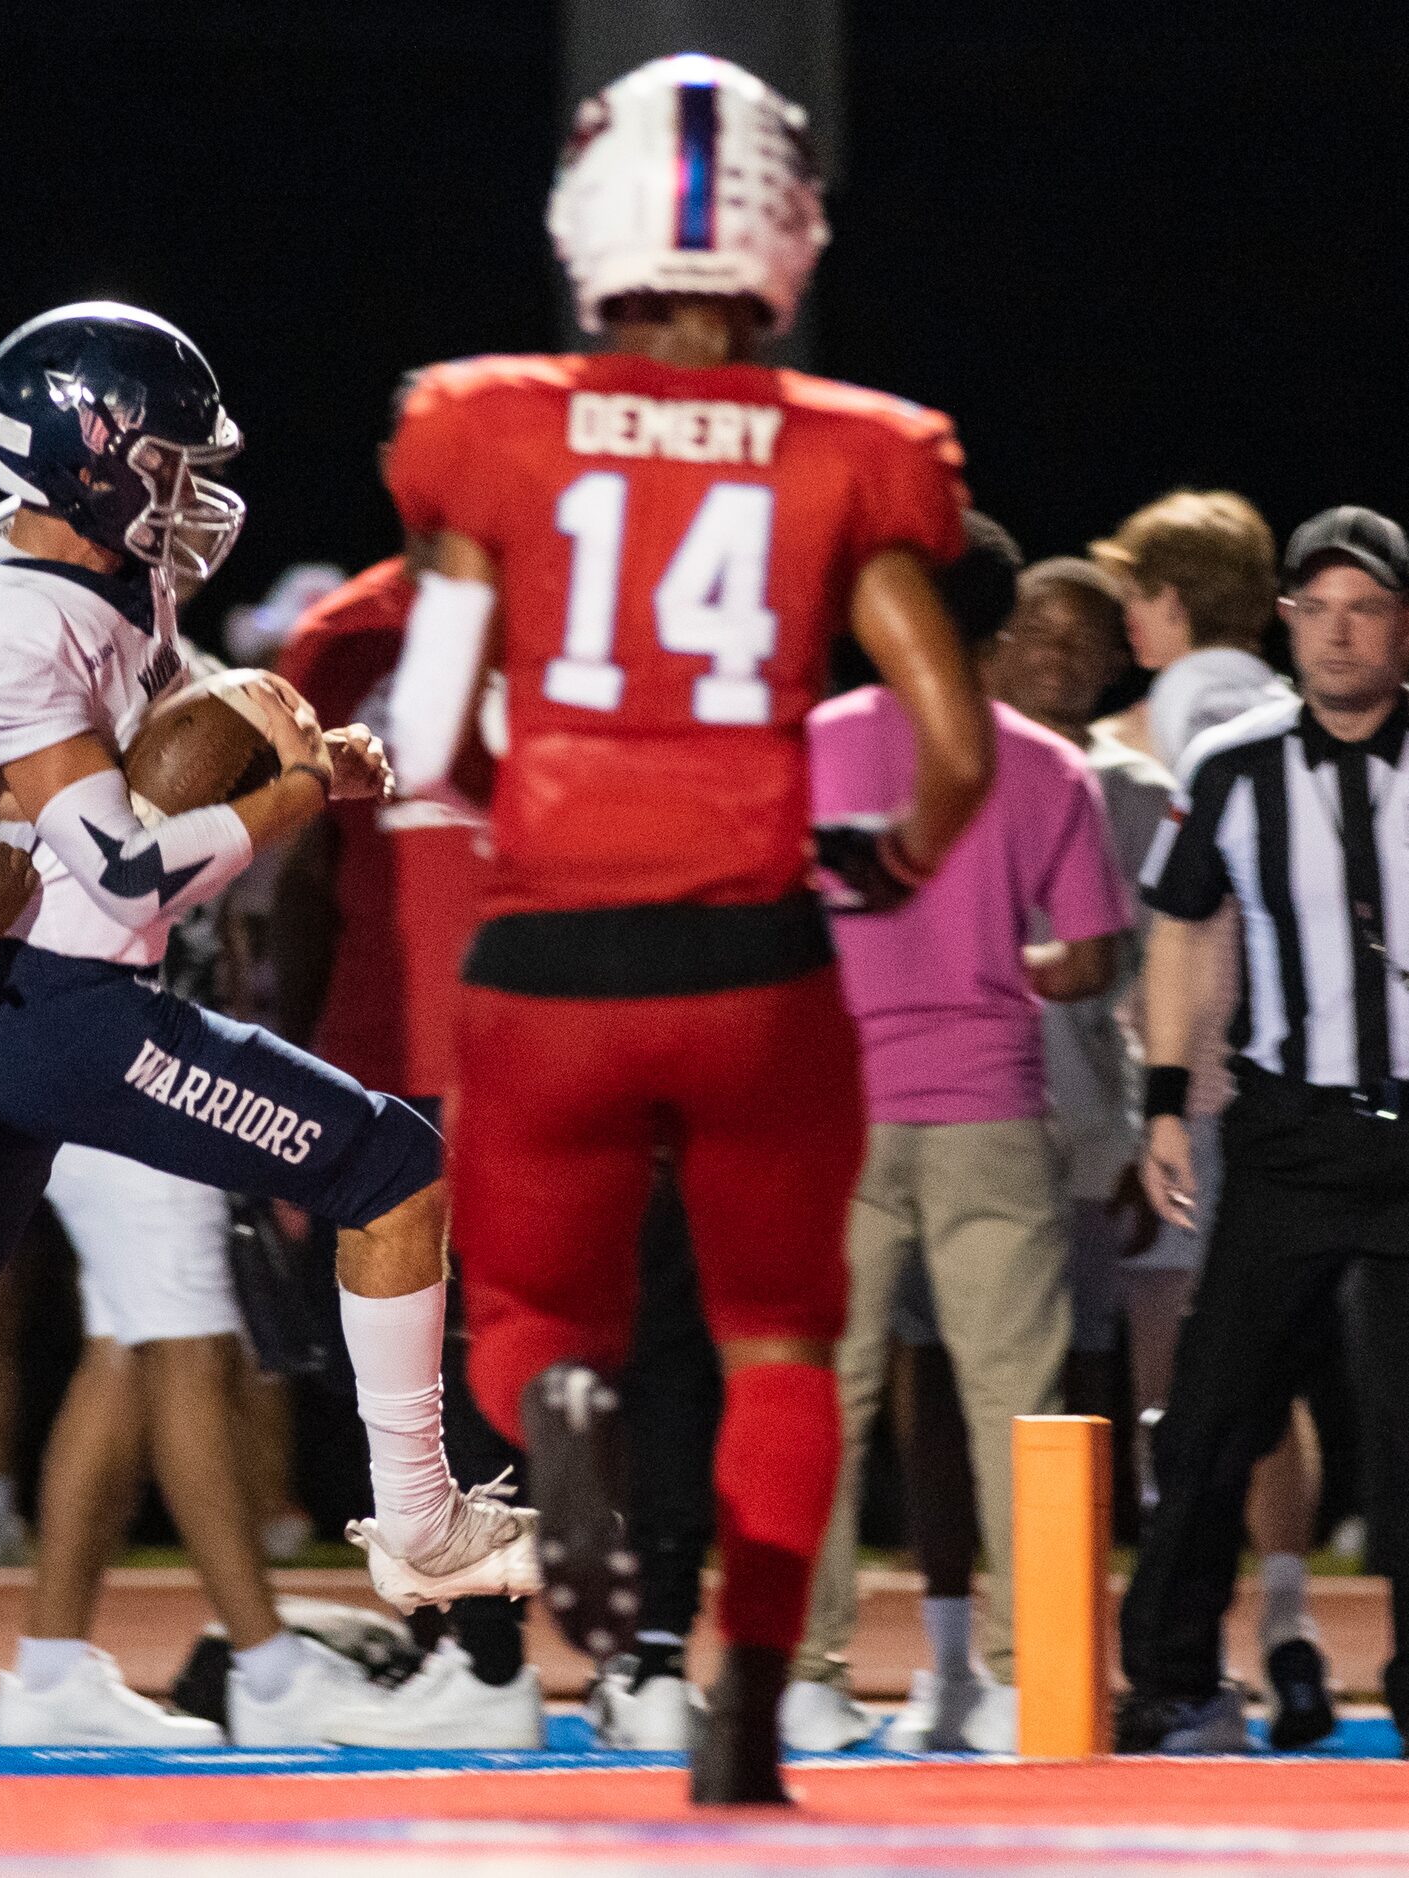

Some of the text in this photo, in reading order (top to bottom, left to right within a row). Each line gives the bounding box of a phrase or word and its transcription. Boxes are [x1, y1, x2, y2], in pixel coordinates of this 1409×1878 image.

[568, 391, 785, 467] DEMERY
[542, 469, 779, 726] 14
[124, 1037, 323, 1165] WARRIORS
